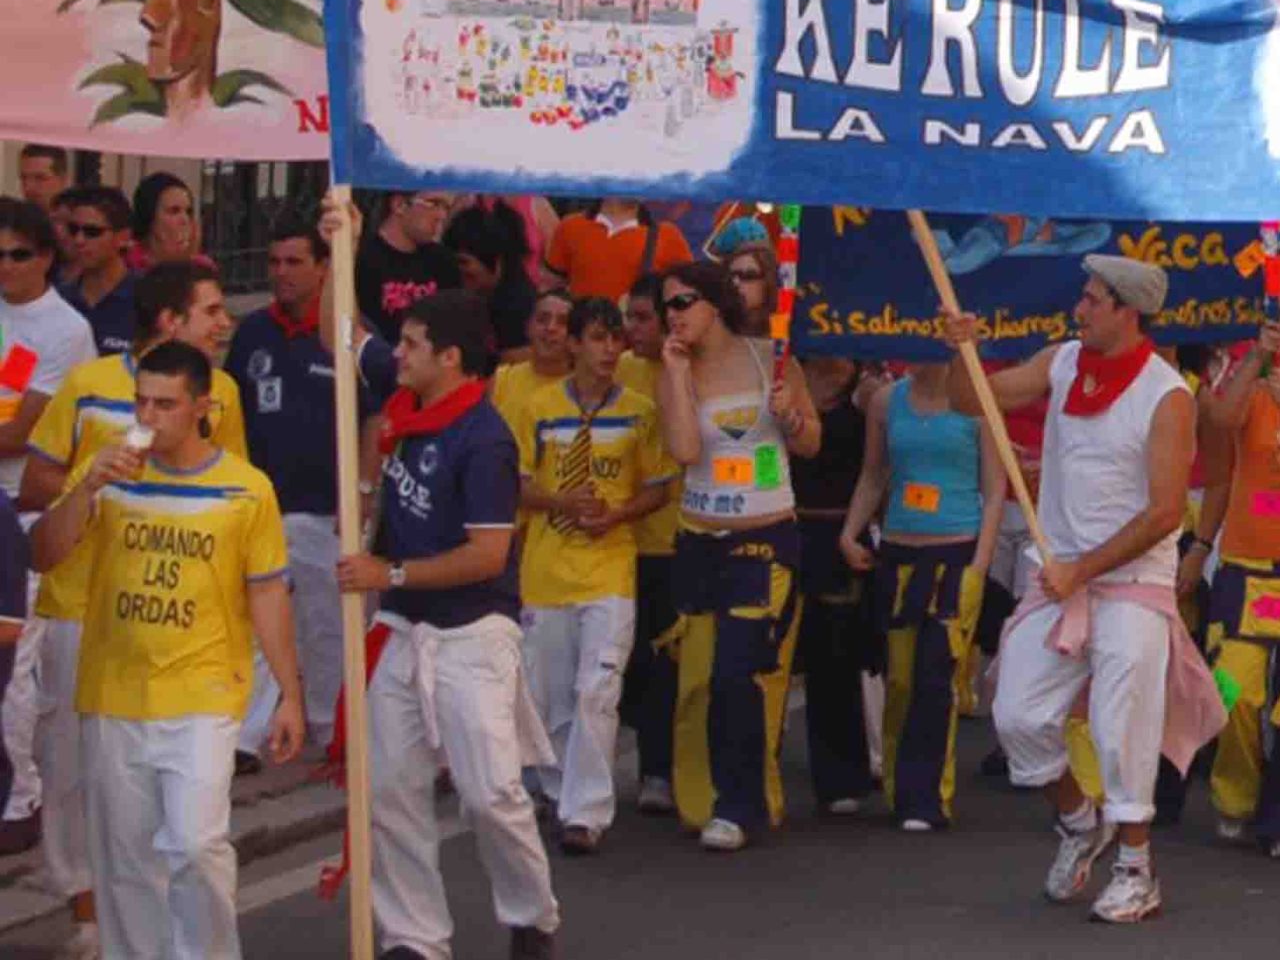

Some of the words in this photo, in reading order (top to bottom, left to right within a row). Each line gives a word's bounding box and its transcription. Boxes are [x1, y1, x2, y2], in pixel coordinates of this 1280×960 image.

[775, 90, 887, 143] LA
[923, 108, 1167, 154] NAVA
[124, 521, 215, 561] COMANDO
[143, 559, 181, 590] LAS
[116, 591, 197, 629] ORDAS
